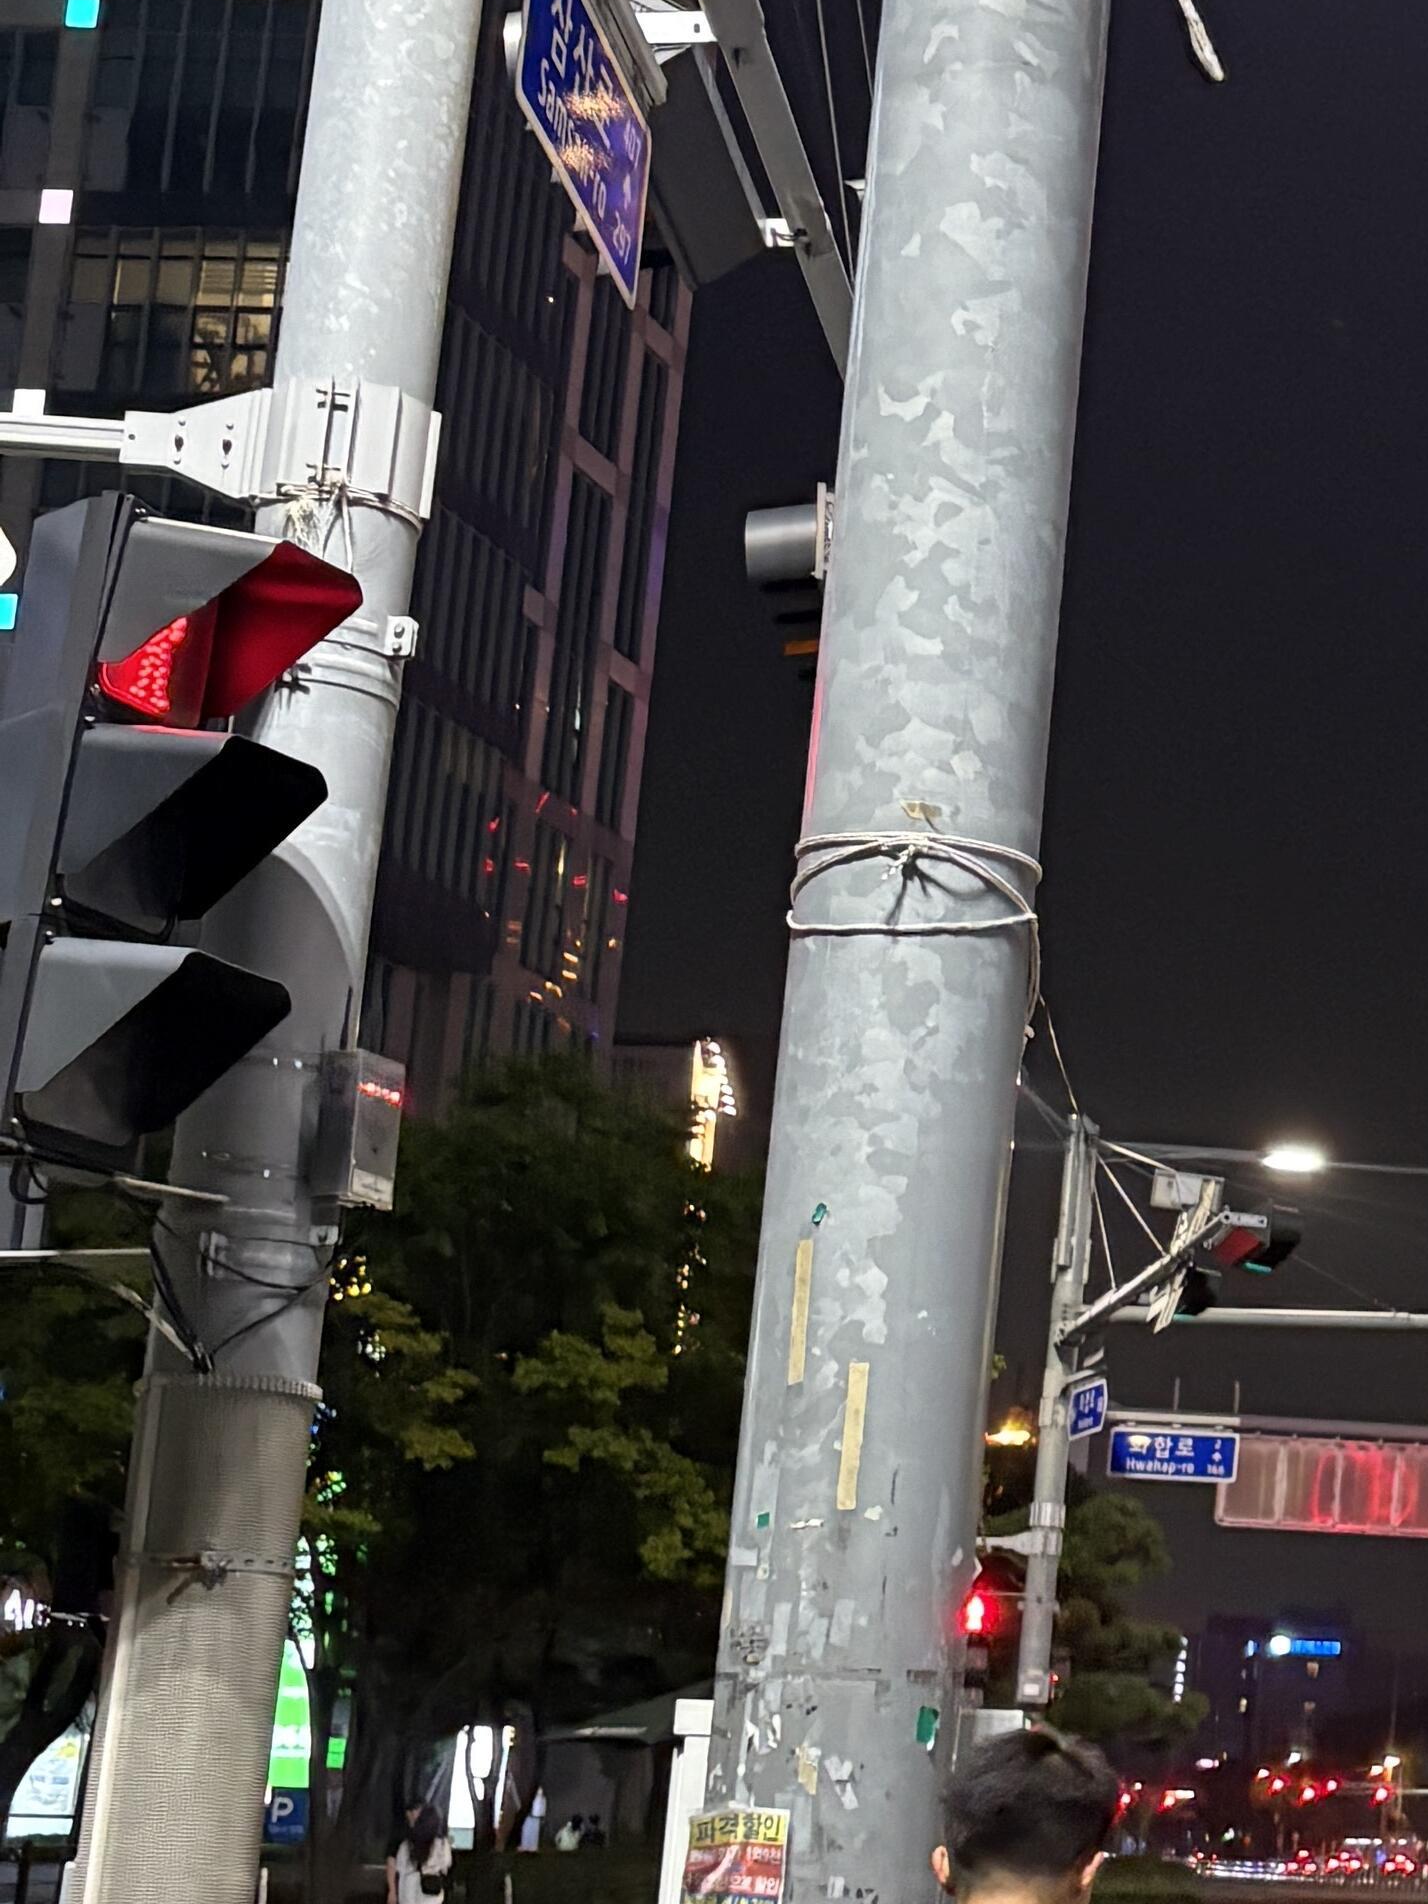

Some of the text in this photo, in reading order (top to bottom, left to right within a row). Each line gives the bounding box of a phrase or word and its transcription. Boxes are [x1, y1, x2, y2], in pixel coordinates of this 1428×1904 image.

[537, 58, 607, 219] Samsn-ro
[1126, 1457, 1194, 1476] Hwahap-ro
[272, 1797, 294, 1823] P
